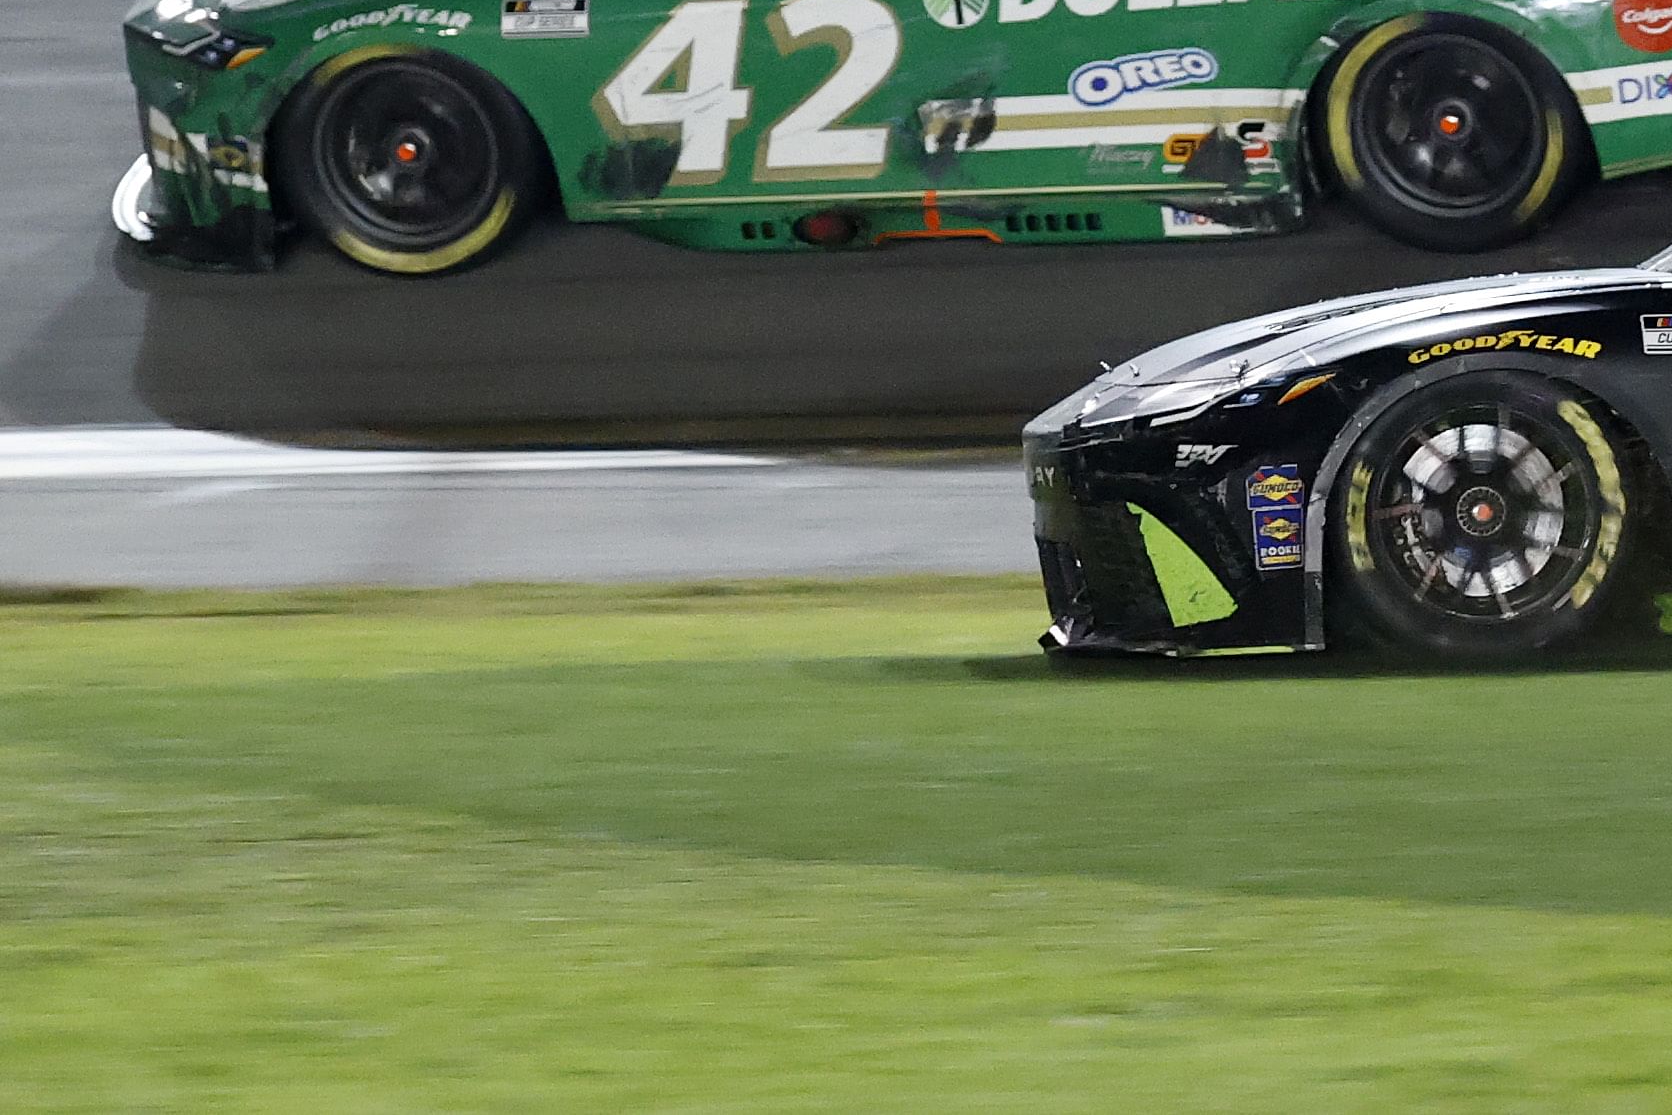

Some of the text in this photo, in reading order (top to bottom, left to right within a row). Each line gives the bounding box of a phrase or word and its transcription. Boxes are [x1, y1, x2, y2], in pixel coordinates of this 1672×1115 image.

[312, 3, 473, 42] GOODYEAR
[1072, 48, 1215, 106] OREO
[1407, 329, 1602, 364] GOODYEAR
